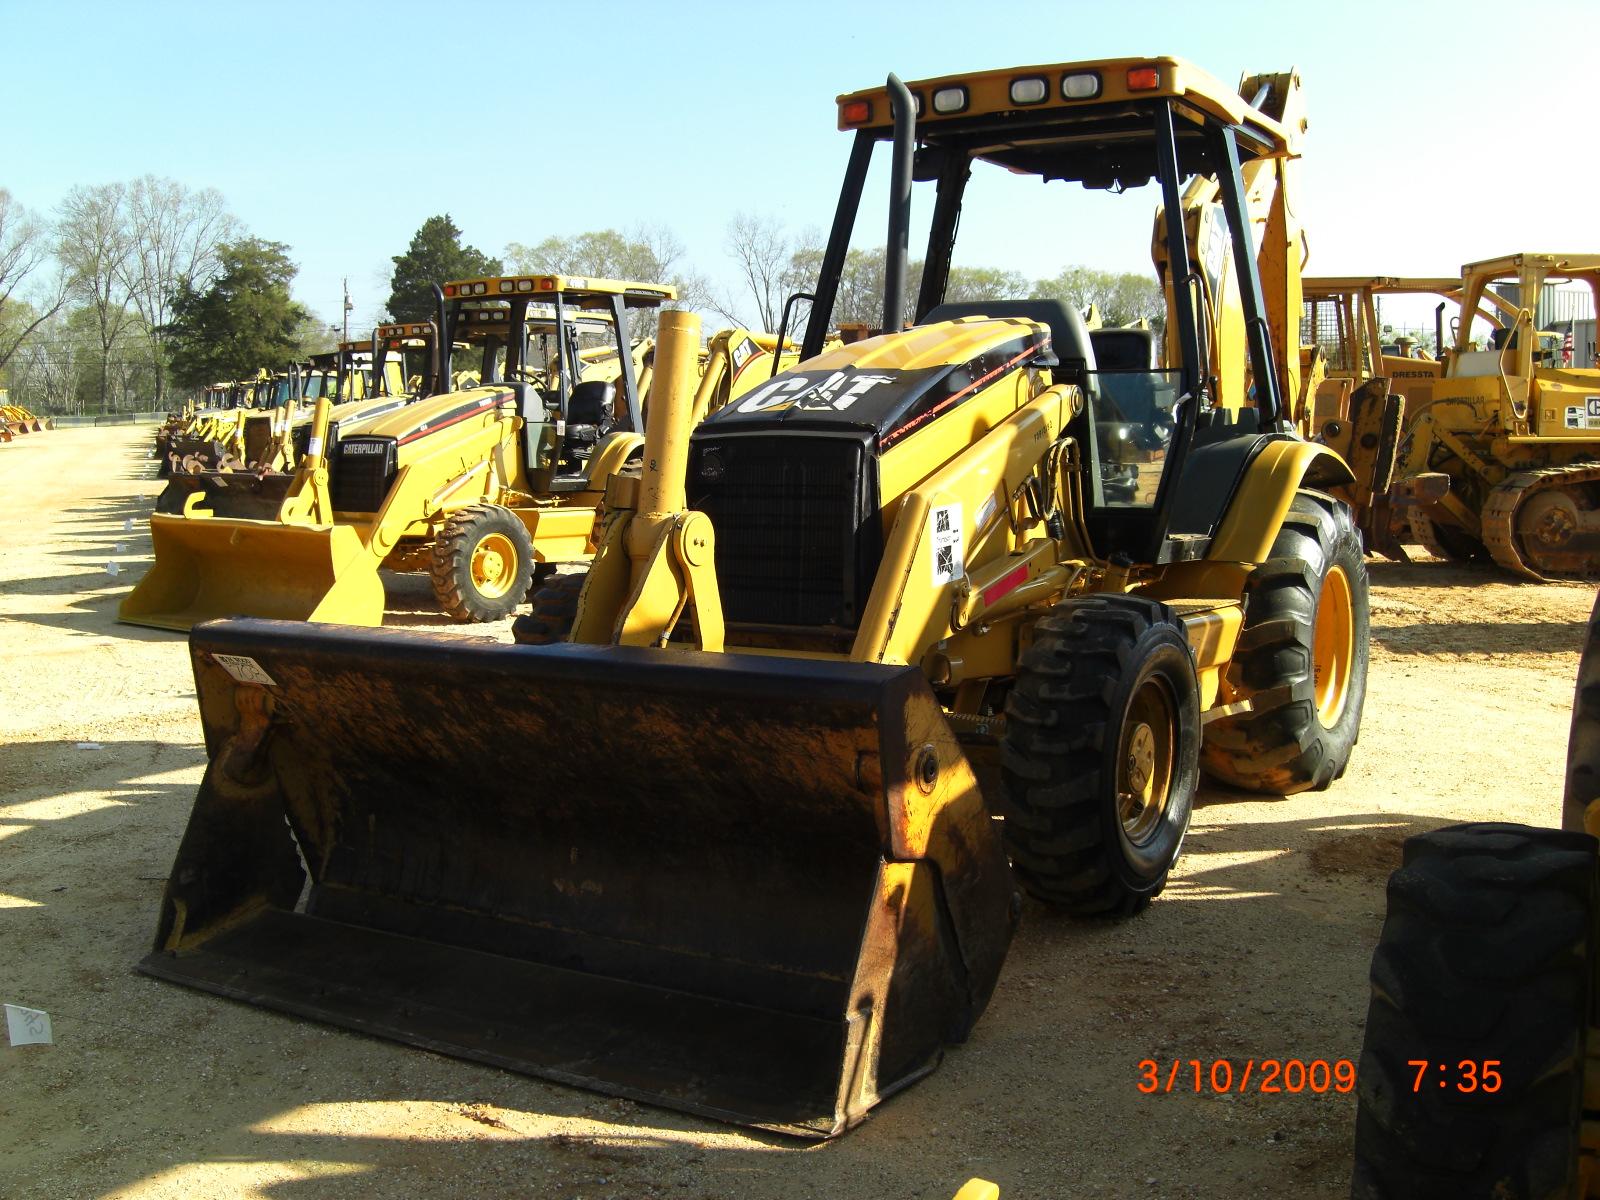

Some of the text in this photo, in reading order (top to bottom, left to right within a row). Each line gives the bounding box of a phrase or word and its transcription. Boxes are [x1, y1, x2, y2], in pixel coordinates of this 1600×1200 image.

[733, 337, 753, 368] CAT
[1392, 371, 1434, 379] DRESSTA
[737, 371, 897, 413] CAT
[343, 443, 384, 455] CATERPILLAR
